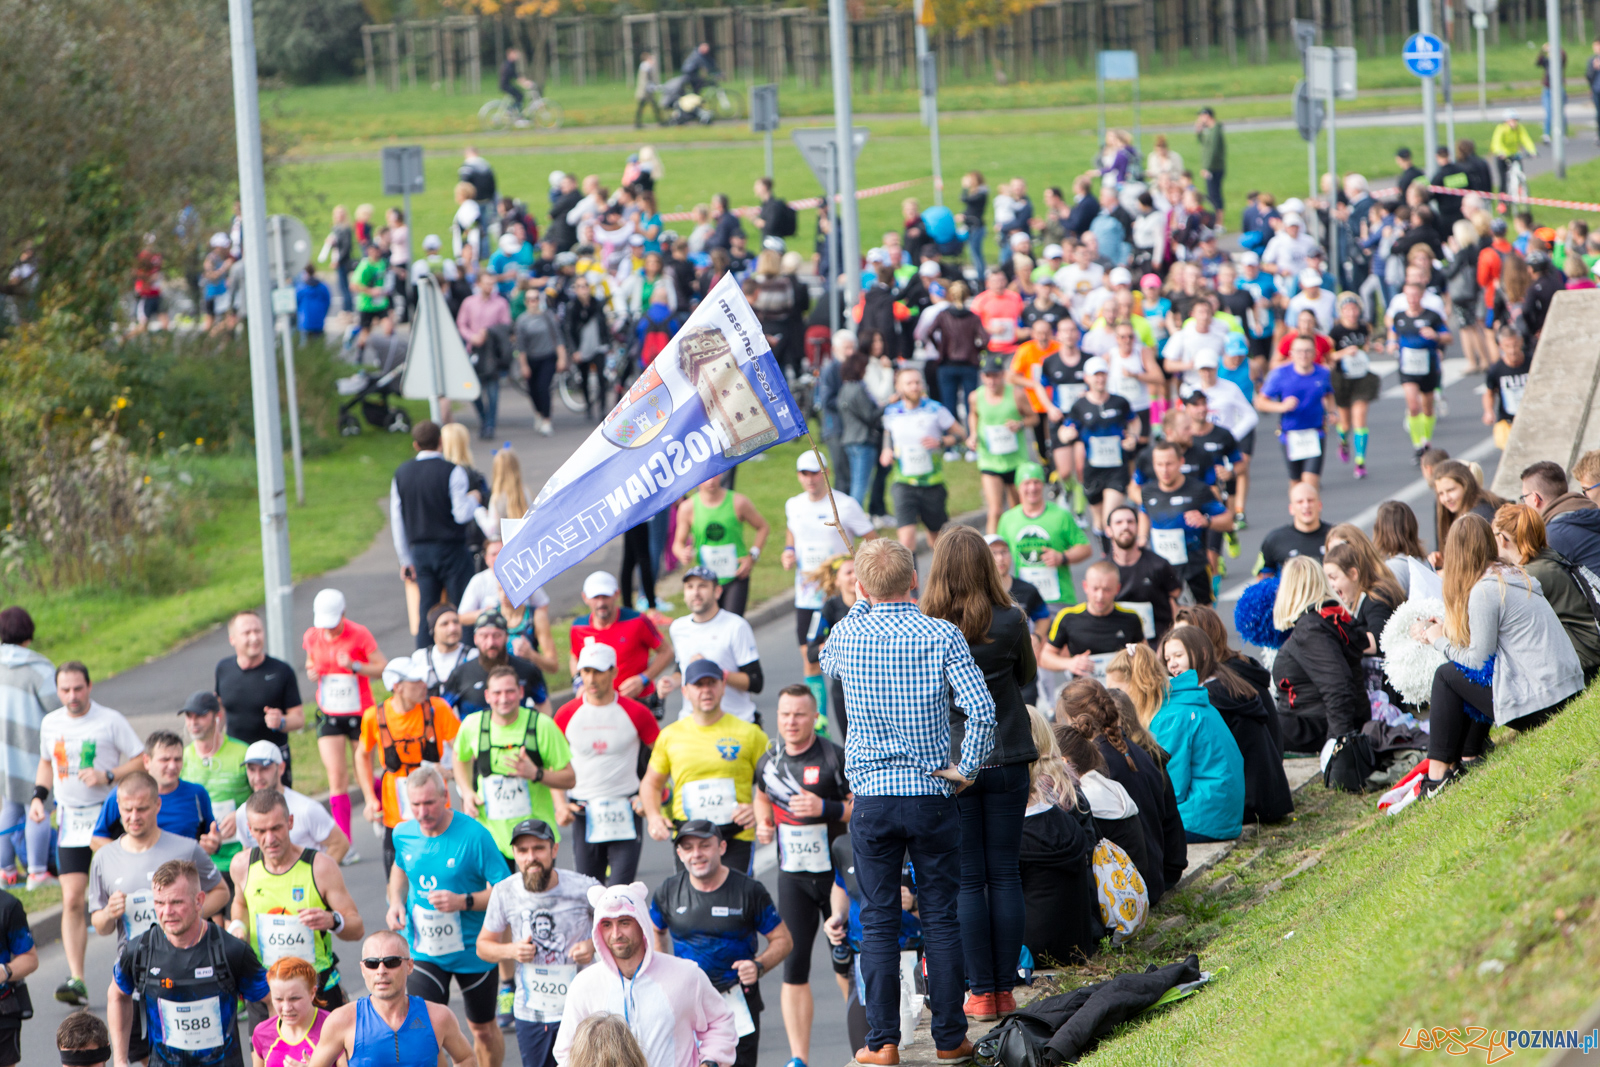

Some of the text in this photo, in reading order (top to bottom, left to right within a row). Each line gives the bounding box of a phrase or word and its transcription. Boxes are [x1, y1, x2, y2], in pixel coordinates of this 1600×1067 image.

[699, 795, 723, 808] 242
[788, 841, 821, 854] 3345
[421, 923, 454, 938] 6390
[269, 932, 306, 946] 6564
[532, 980, 569, 996] 2620
[174, 1016, 211, 1032] 1588
